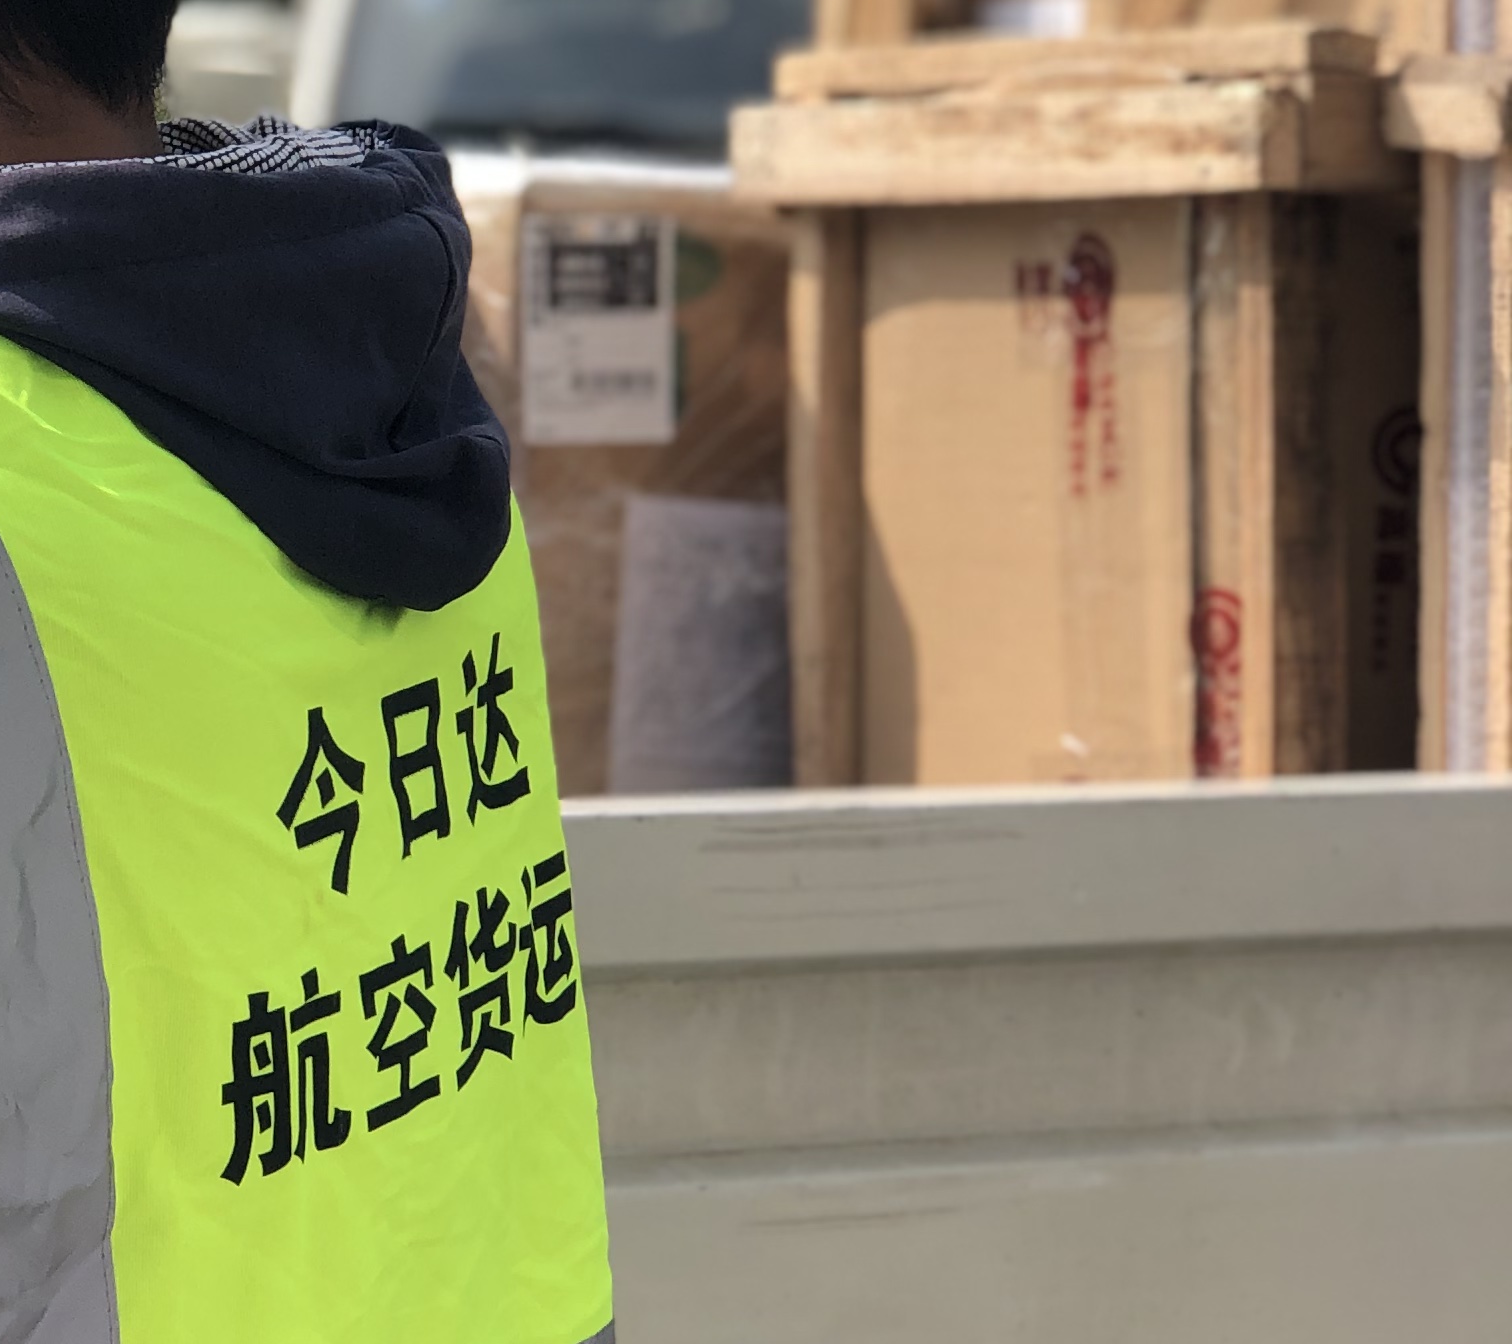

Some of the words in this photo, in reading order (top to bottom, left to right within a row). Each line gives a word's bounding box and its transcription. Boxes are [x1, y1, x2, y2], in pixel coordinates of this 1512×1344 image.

[276, 632, 531, 896] 今日达
[220, 850, 577, 1186] 航空货运
